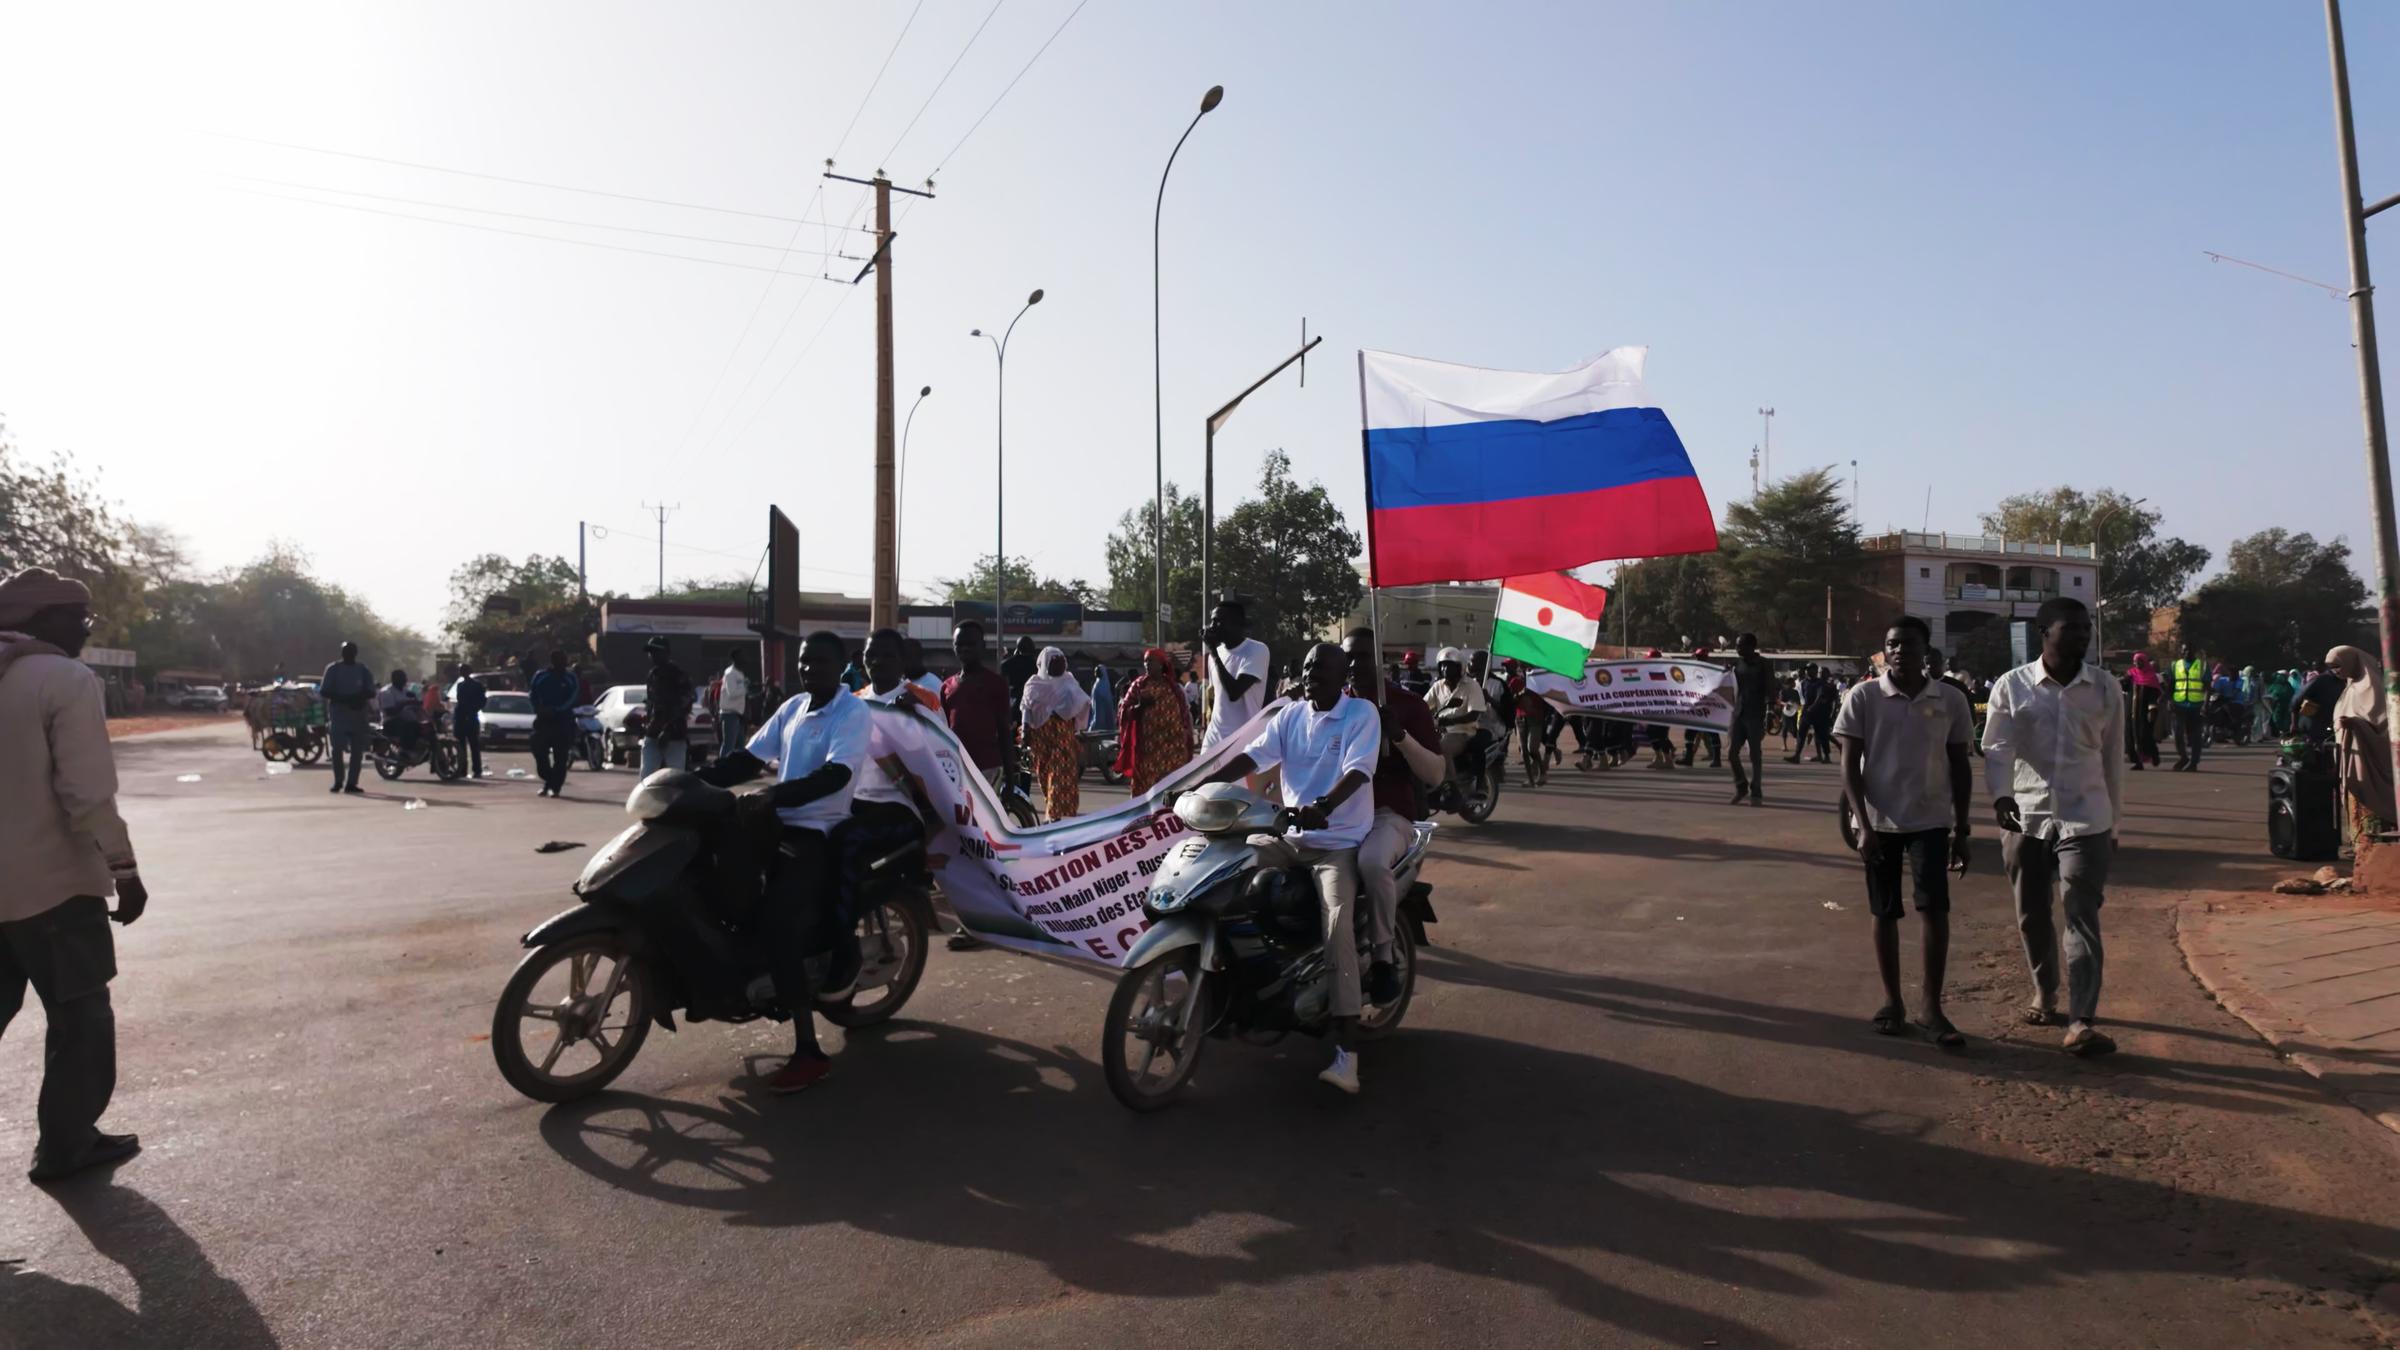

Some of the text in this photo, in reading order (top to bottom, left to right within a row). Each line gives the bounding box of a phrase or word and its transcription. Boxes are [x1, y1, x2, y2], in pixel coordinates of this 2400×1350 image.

[1579, 692, 1599, 703] VIVE
[1601, 691, 1611, 700] LA
[1103, 814, 1184, 864] AES-RU
[1047, 901, 1063, 914] la
[1060, 887, 1095, 911] Main
[1093, 871, 1131, 898] Niger
[1097, 902, 1125, 924] des
